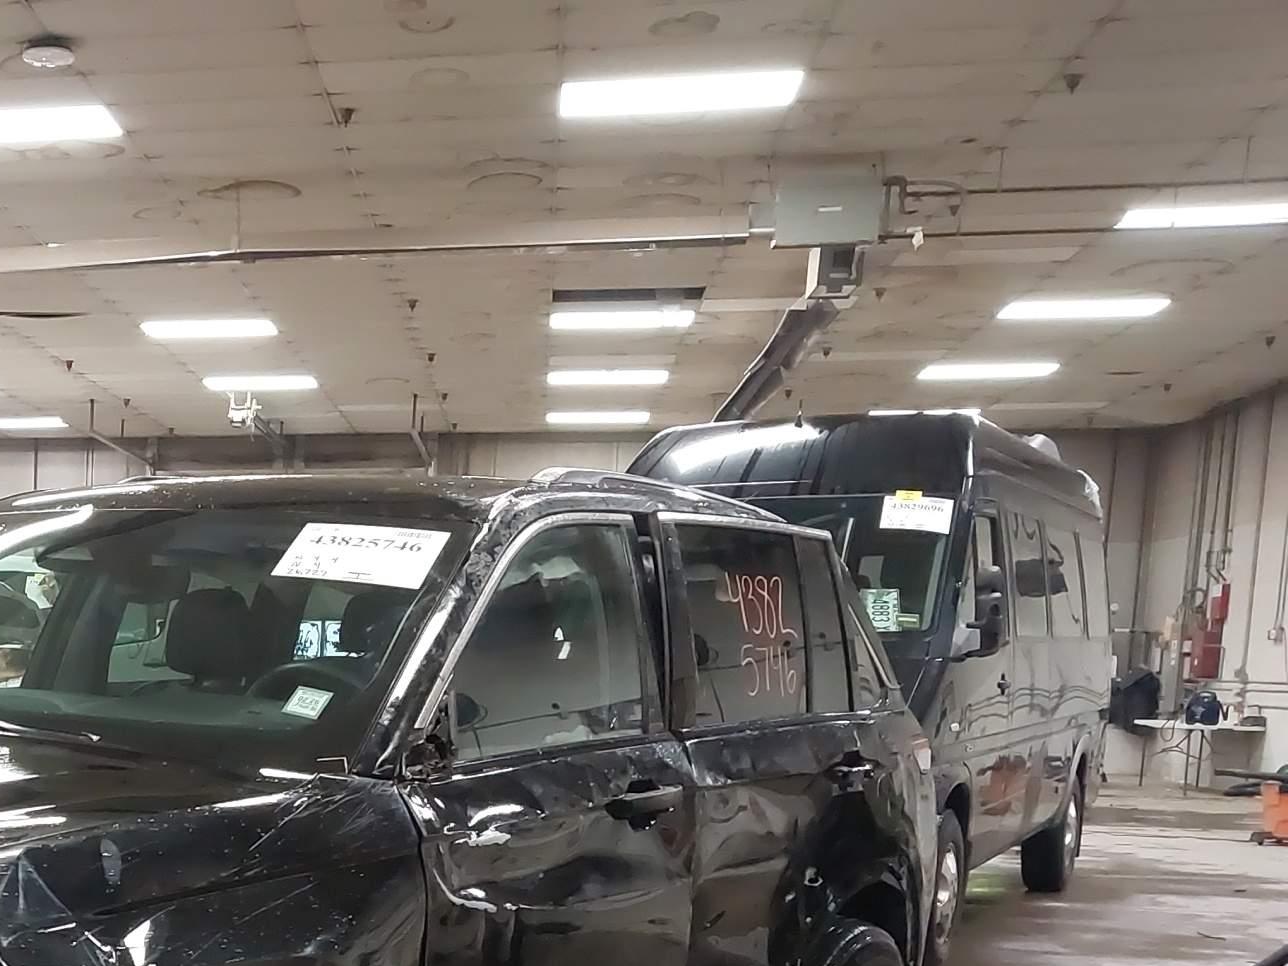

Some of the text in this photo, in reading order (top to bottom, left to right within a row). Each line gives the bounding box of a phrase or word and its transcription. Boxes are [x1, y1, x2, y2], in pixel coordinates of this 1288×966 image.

[310, 535, 423, 552] 43825746
[724, 570, 799, 639] 4382
[739, 642, 798, 697] 5746
